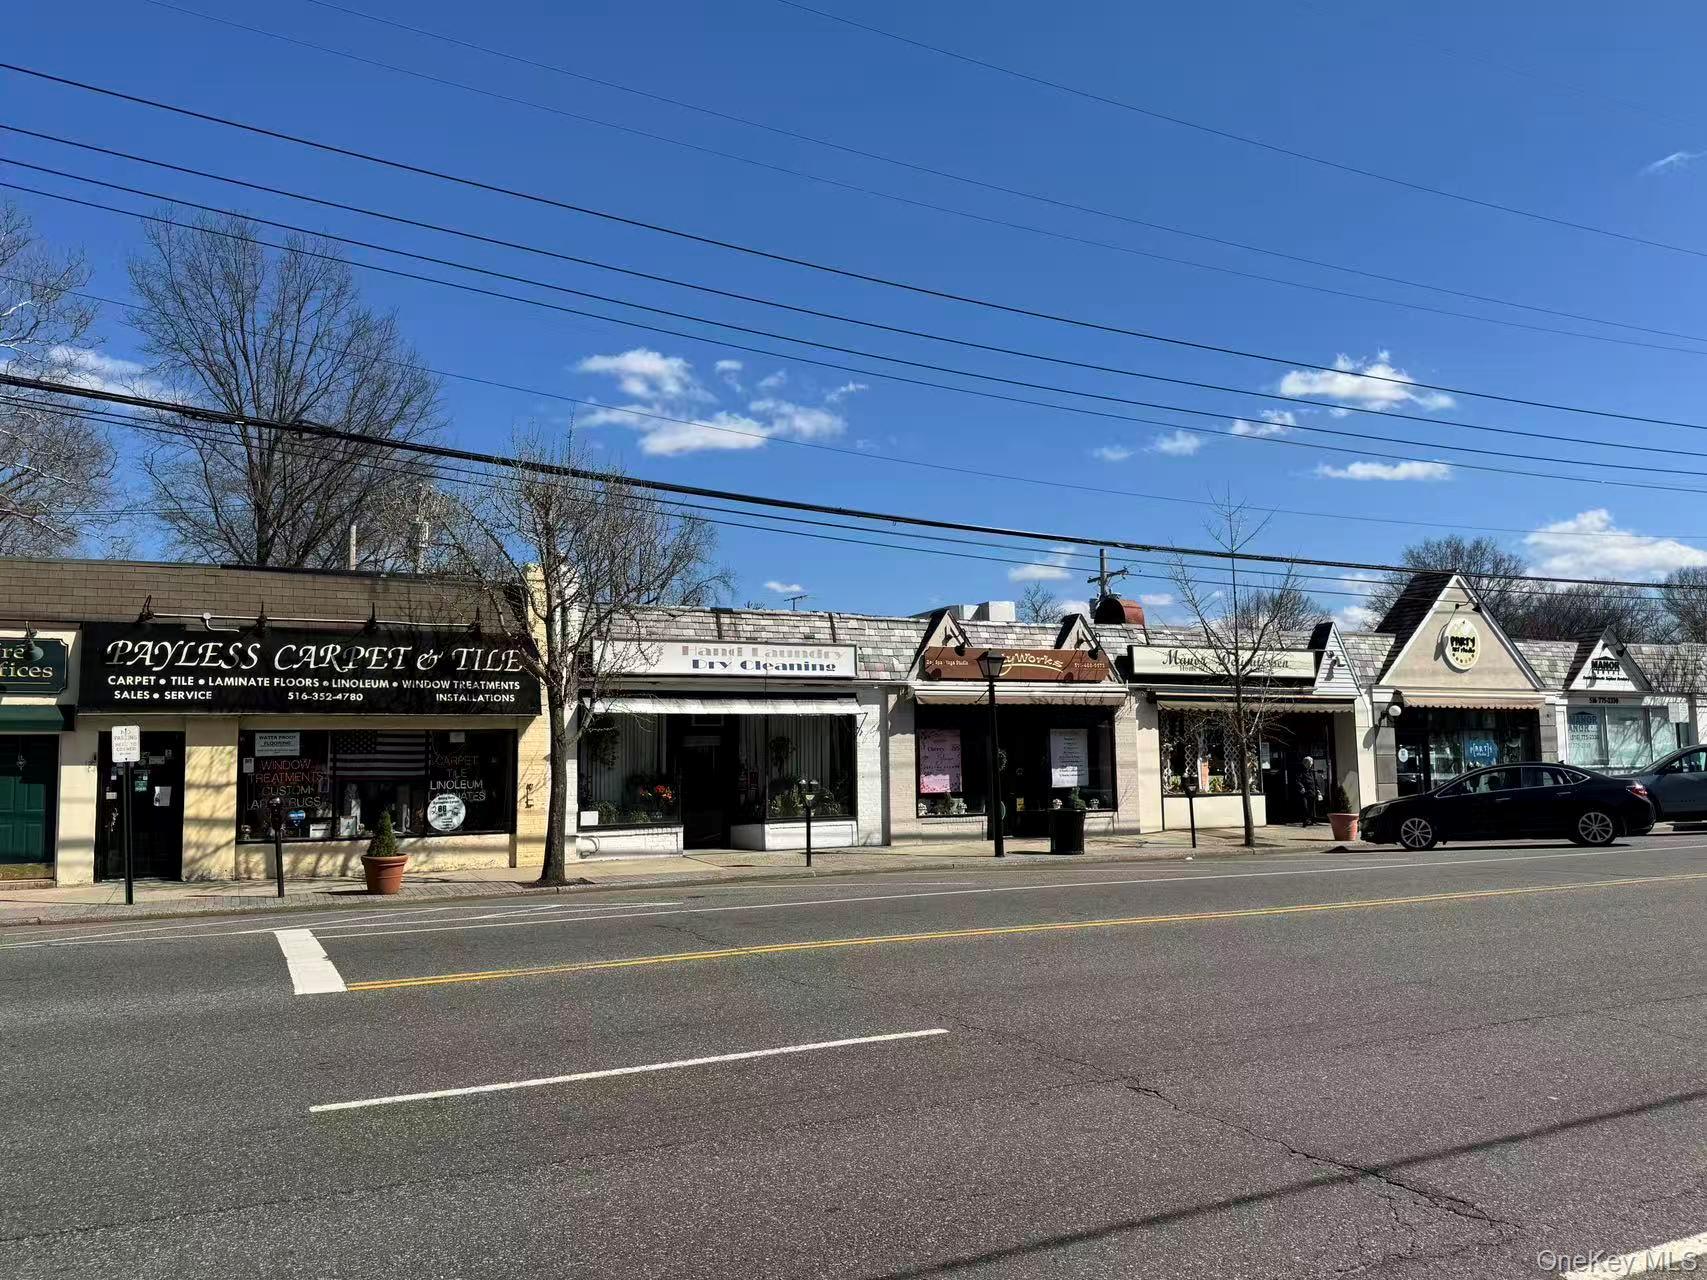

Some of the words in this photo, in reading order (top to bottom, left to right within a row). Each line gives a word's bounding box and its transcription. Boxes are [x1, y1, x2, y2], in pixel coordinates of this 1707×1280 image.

[105, 640, 261, 671] PAYLESS
[274, 643, 413, 673] CARPET
[416, 648, 444, 671] &
[451, 647, 523, 672] TILE
[682, 645, 743, 657] Hand
[752, 647, 843, 660] Laundry
[692, 659, 732, 670] Dry
[740, 660, 836, 672] Cleaning
[1001, 652, 1064, 668] yWorks
[1591, 660, 1620, 670] MANOR
[107, 675, 156, 686] CARPET
[170, 676, 194, 686] TILE
[208, 676, 270, 687] LAMINATE
[273, 677, 319, 687] FLOORS
[332, 678, 390, 688] LINOLEUM
[401, 679, 451, 689] WINDOW
[453, 680, 521, 690] TREATMENTS
[114, 690, 150, 700] SALES
[164, 691, 212, 700] SERVICE
[287, 692, 364, 701] 516-352-4780
[436, 693, 515, 702] INSTALLATIONS
[430, 780, 483, 790] LINOLEUM
